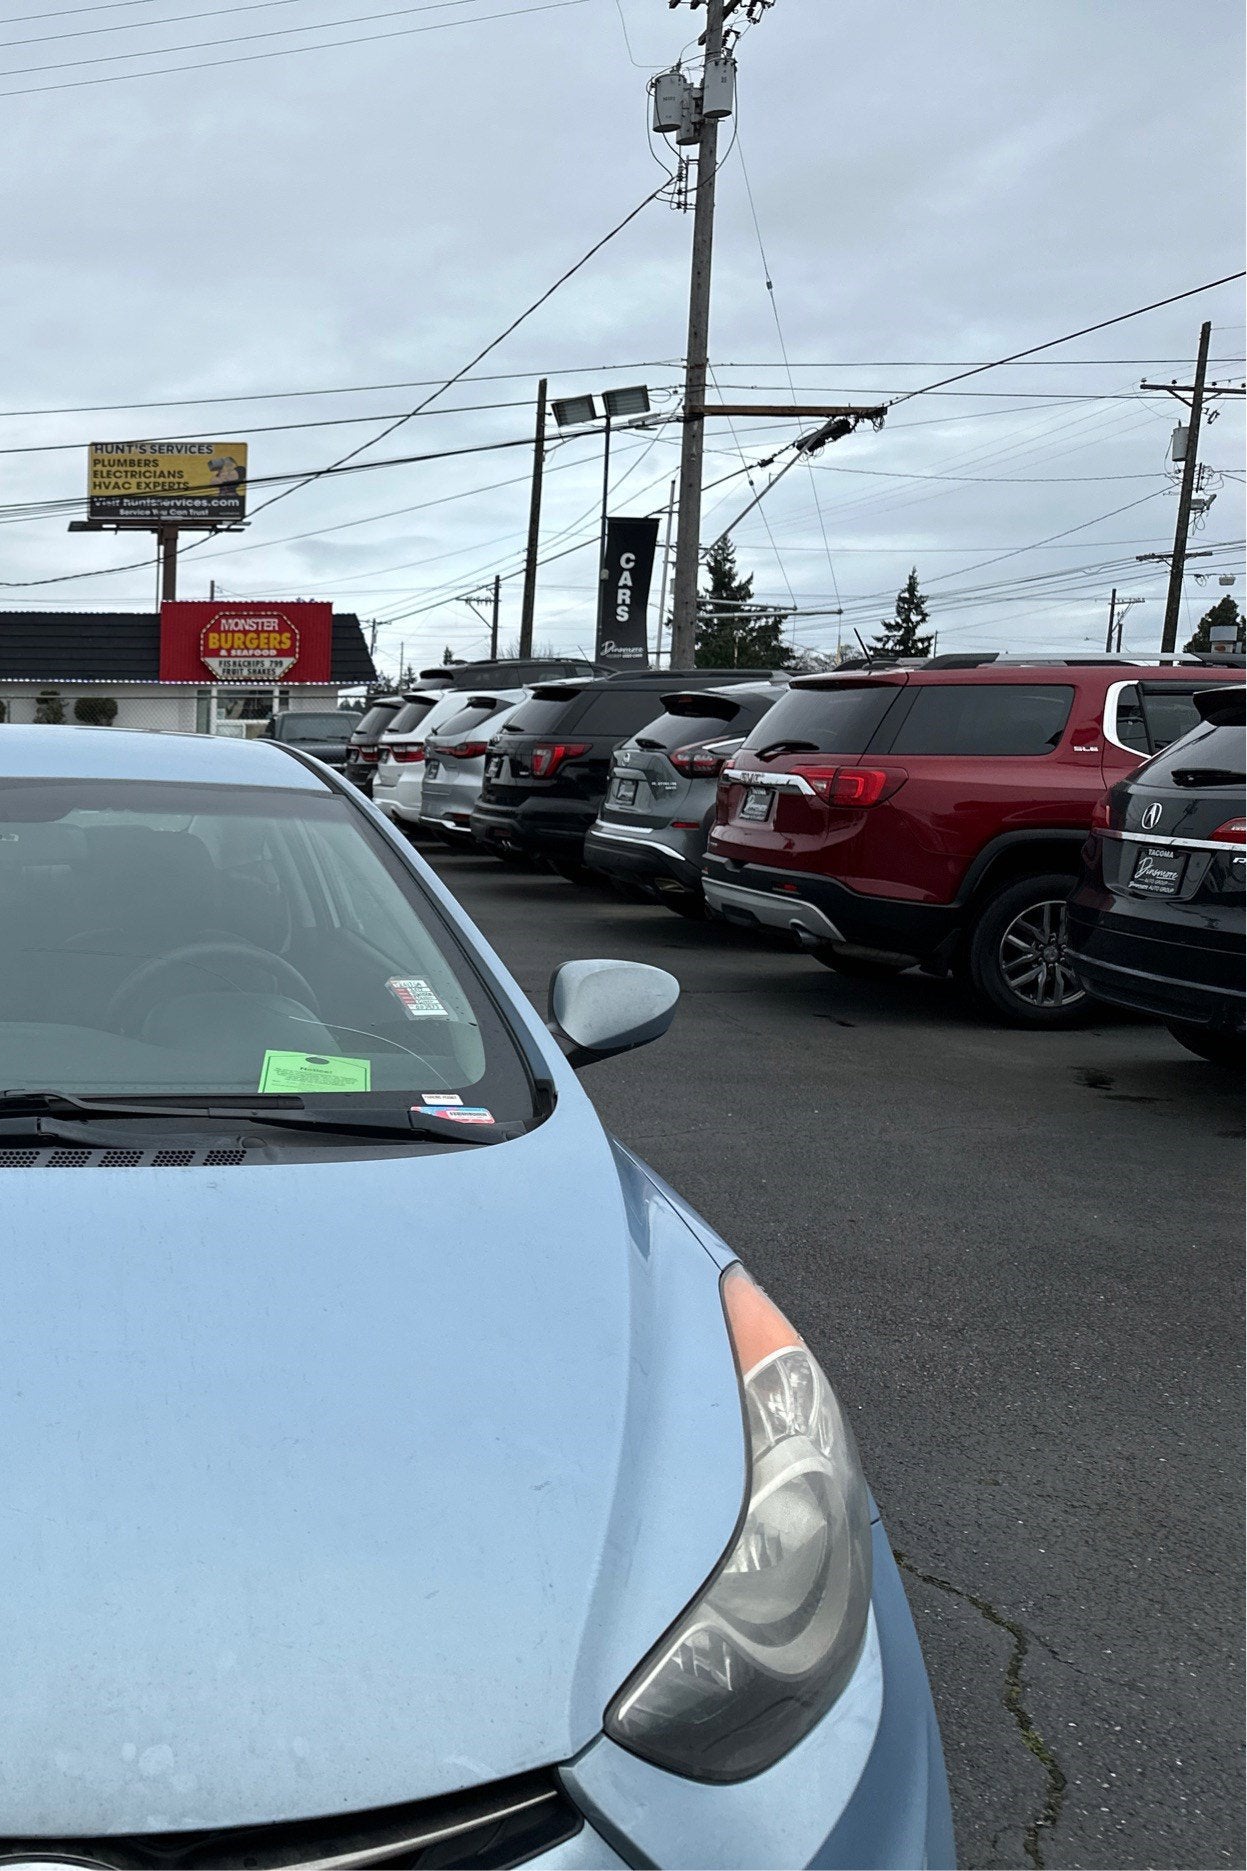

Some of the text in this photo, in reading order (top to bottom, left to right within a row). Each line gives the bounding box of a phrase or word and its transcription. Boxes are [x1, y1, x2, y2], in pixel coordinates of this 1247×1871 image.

[94, 443, 214, 455] HUNT'S SERVICES
[93, 458, 160, 468] PLUMBERS
[93, 470, 184, 479] ELECTRICIANS
[93, 481, 190, 491] HVAC EXPERTS
[119, 508, 151, 517] Service
[169, 508, 188, 517] Can
[189, 508, 209, 517] Trust
[616, 552, 636, 622] CARS
[220, 618, 279, 631] MONSTER
[208, 632, 292, 650] BURGERS
[269, 660, 283, 668] 799
[1148, 848, 1174, 858] TACOMA
